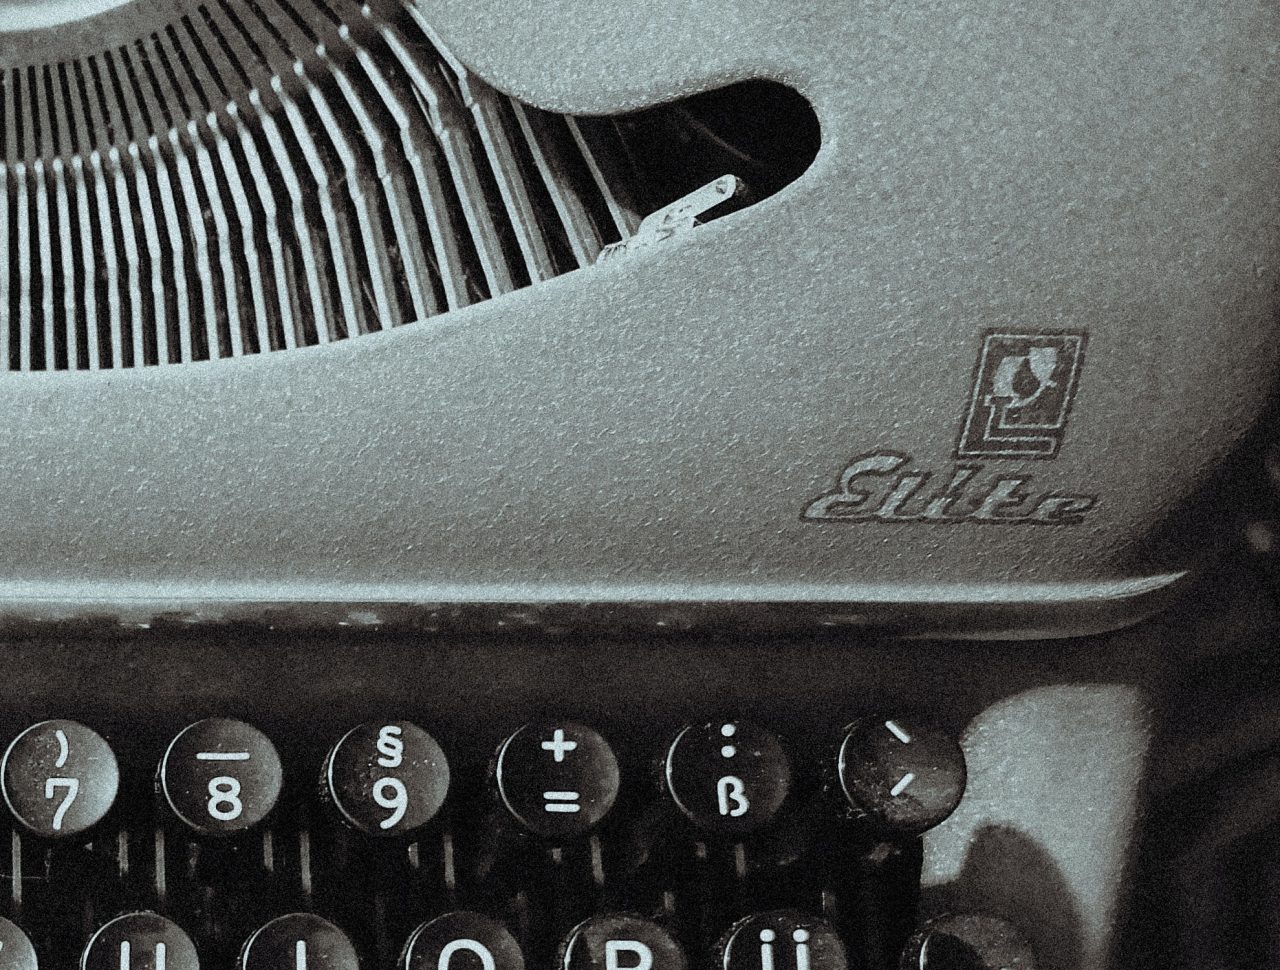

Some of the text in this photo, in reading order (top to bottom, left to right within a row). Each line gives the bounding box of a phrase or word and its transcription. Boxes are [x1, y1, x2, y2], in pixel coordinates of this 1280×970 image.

[802, 453, 1096, 521] Elite
[54, 729, 69, 768] )
[376, 725, 404, 768] §
[541, 728, 578, 763] +
[44, 777, 80, 831] 7
[206, 776, 243, 821] 8
[371, 776, 408, 830] 9
[542, 791, 581, 813] =
